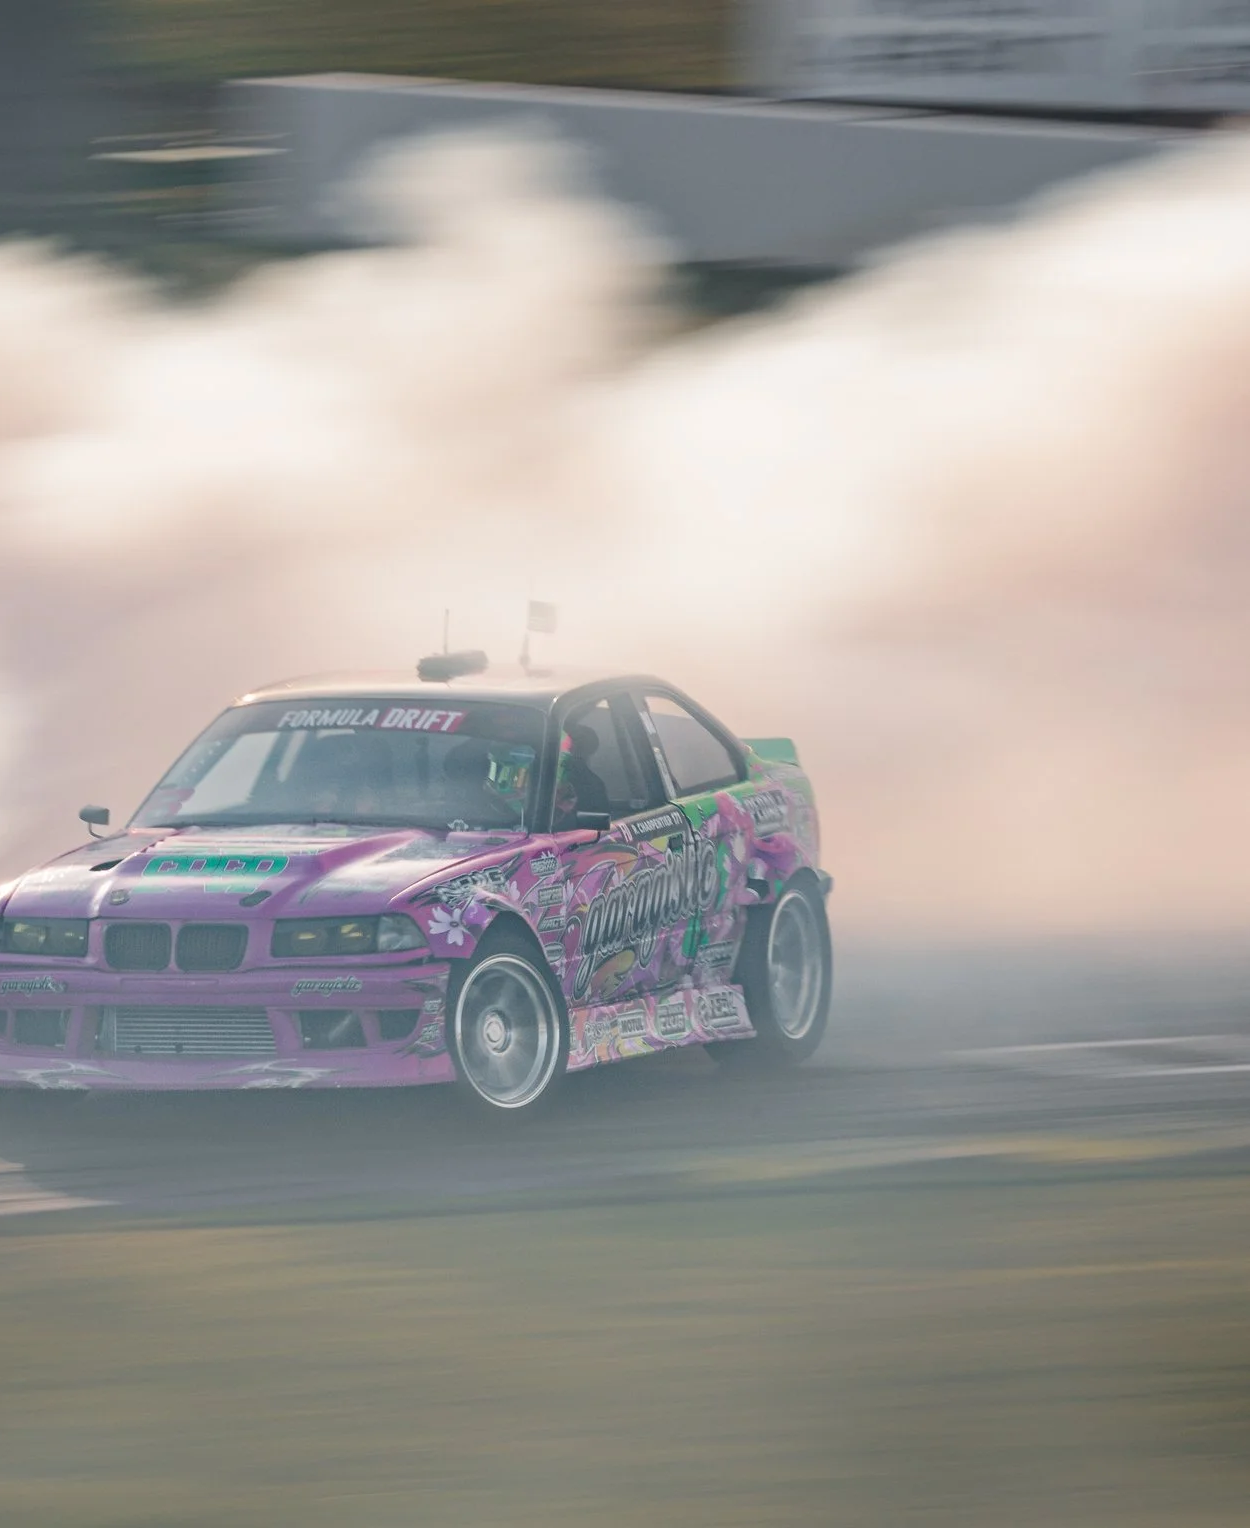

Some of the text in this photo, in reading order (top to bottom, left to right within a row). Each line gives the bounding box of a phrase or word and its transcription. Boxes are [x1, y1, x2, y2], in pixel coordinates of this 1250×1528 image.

[277, 707, 463, 732] FORMULA DRIFT
[620, 1015, 645, 1034] MOTUL
